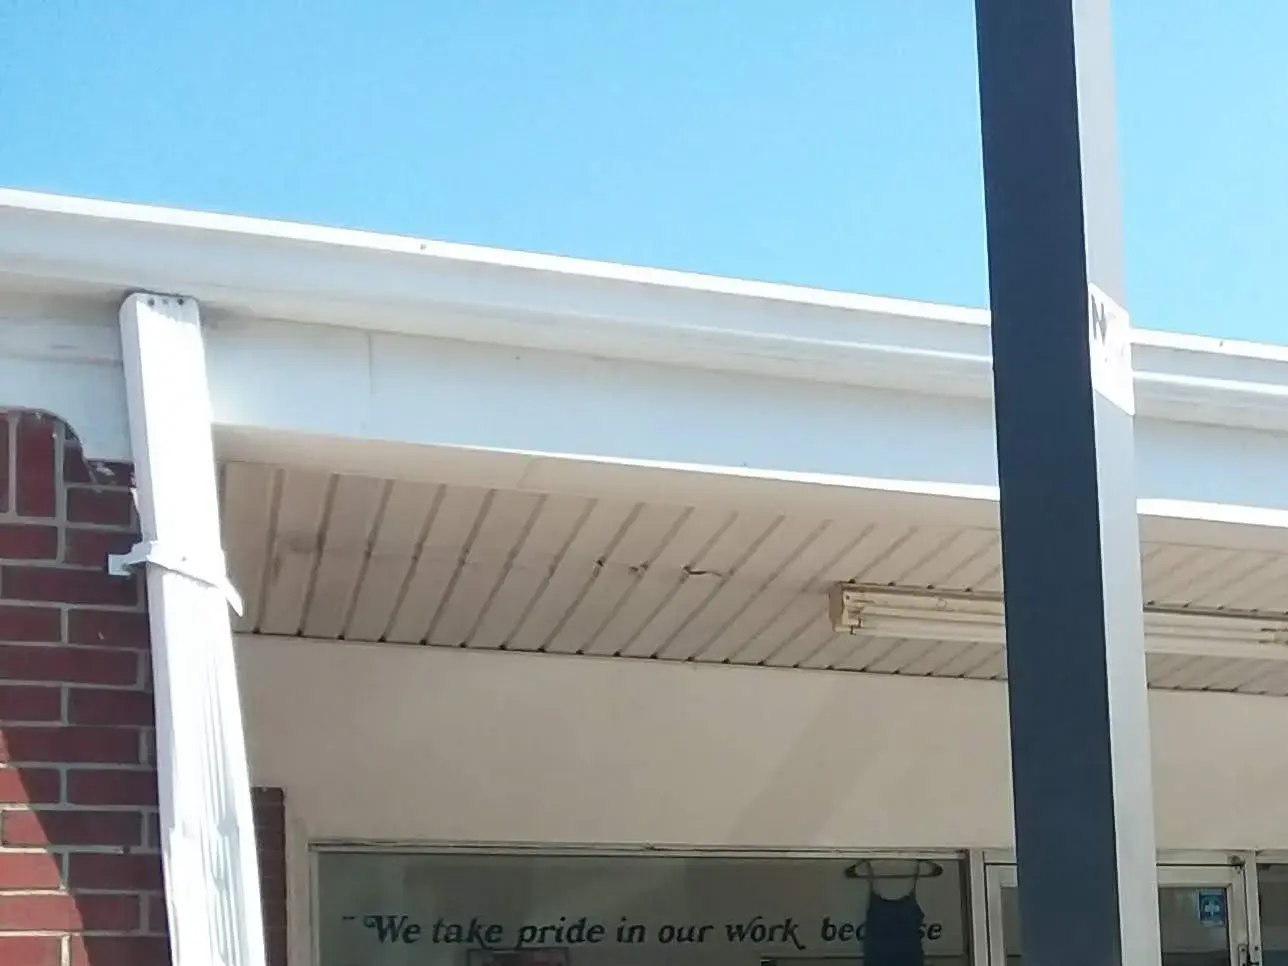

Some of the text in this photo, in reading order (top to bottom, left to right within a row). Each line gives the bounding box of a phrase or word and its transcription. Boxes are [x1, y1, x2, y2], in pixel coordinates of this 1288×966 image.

[432, 915, 504, 949] take
[514, 915, 607, 949] pride
[615, 915, 647, 944] in
[656, 923, 714, 944] our
[723, 915, 807, 950] work
[820, 916, 943, 943] becse
